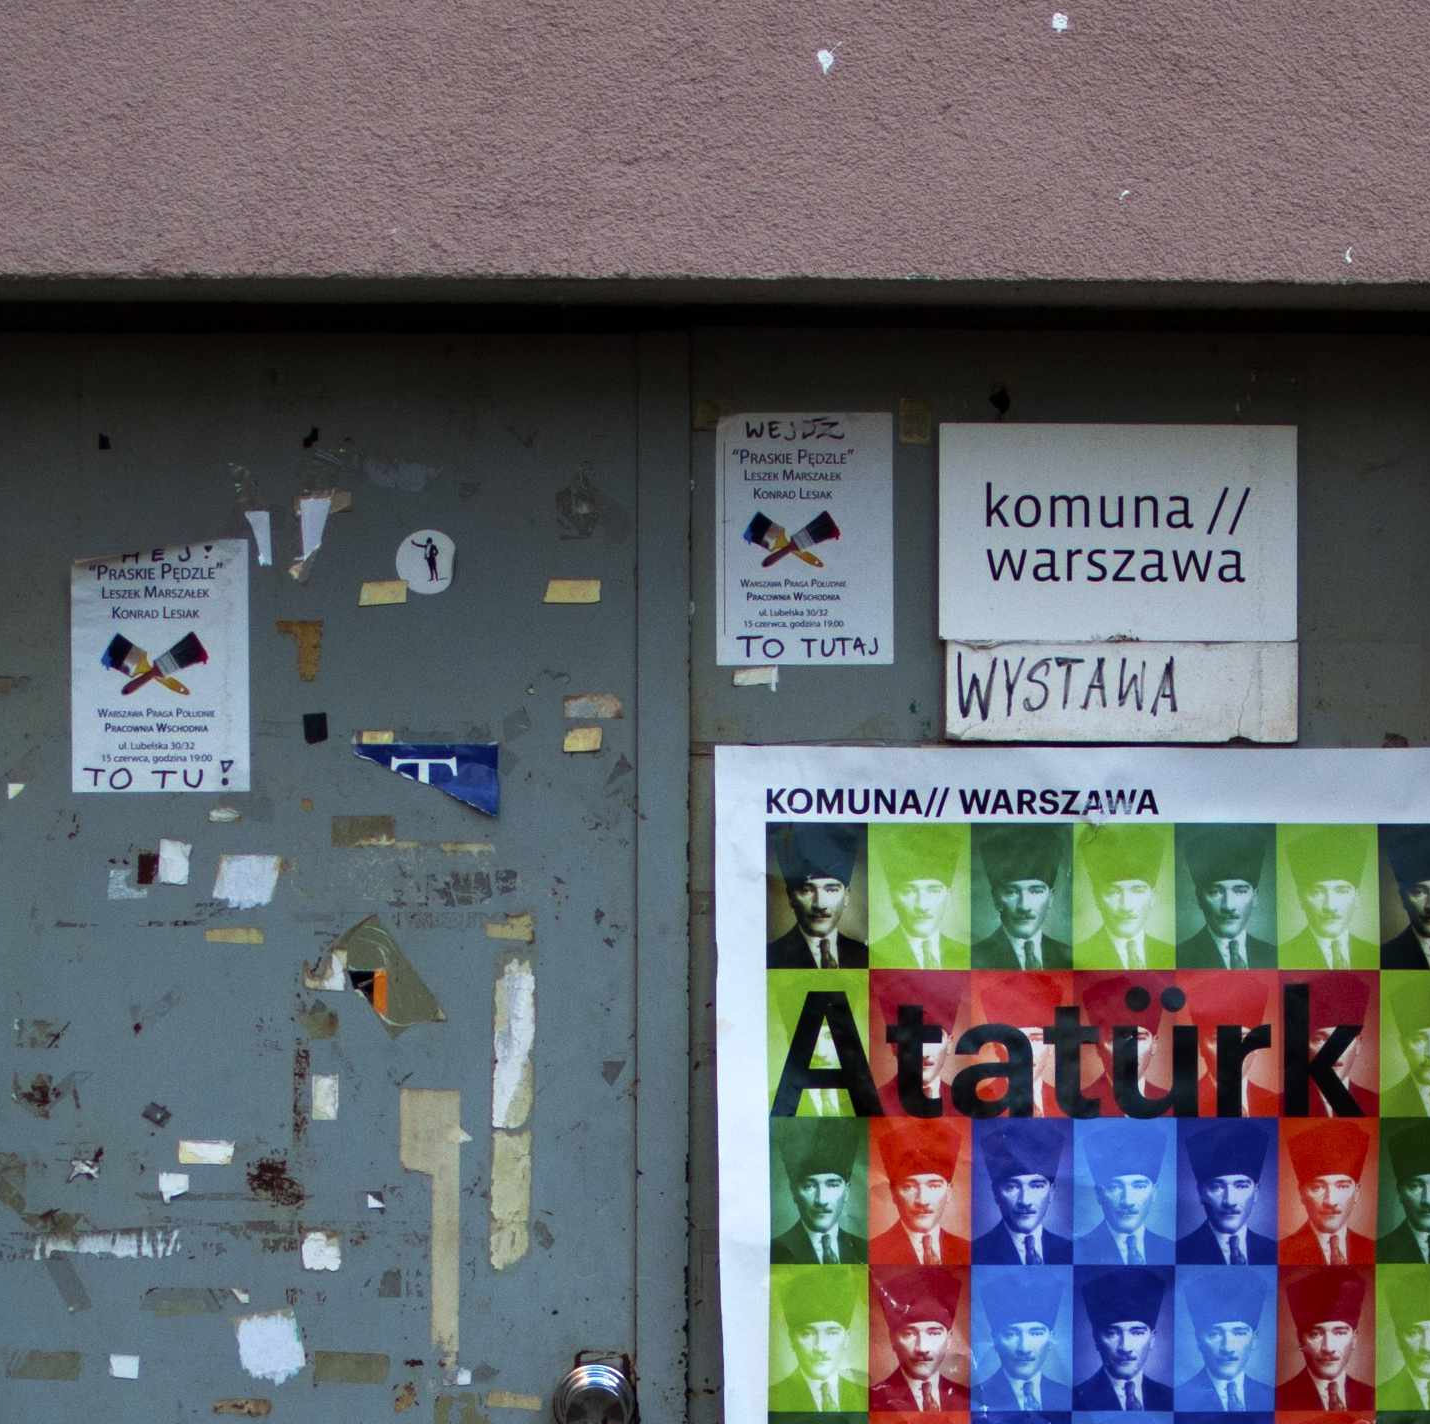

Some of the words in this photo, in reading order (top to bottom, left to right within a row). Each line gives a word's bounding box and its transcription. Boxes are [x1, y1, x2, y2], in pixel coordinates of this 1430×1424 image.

[986, 547, 1246, 583] warszawa
[736, 635, 785, 659] TO
[800, 637, 879, 659] TUTAJ
[957, 651, 1178, 721] WYSTAWA
[83, 768, 132, 790] TO
[959, 788, 1159, 817] WARSZAWA
[769, 983, 1367, 1120] Atatürk
